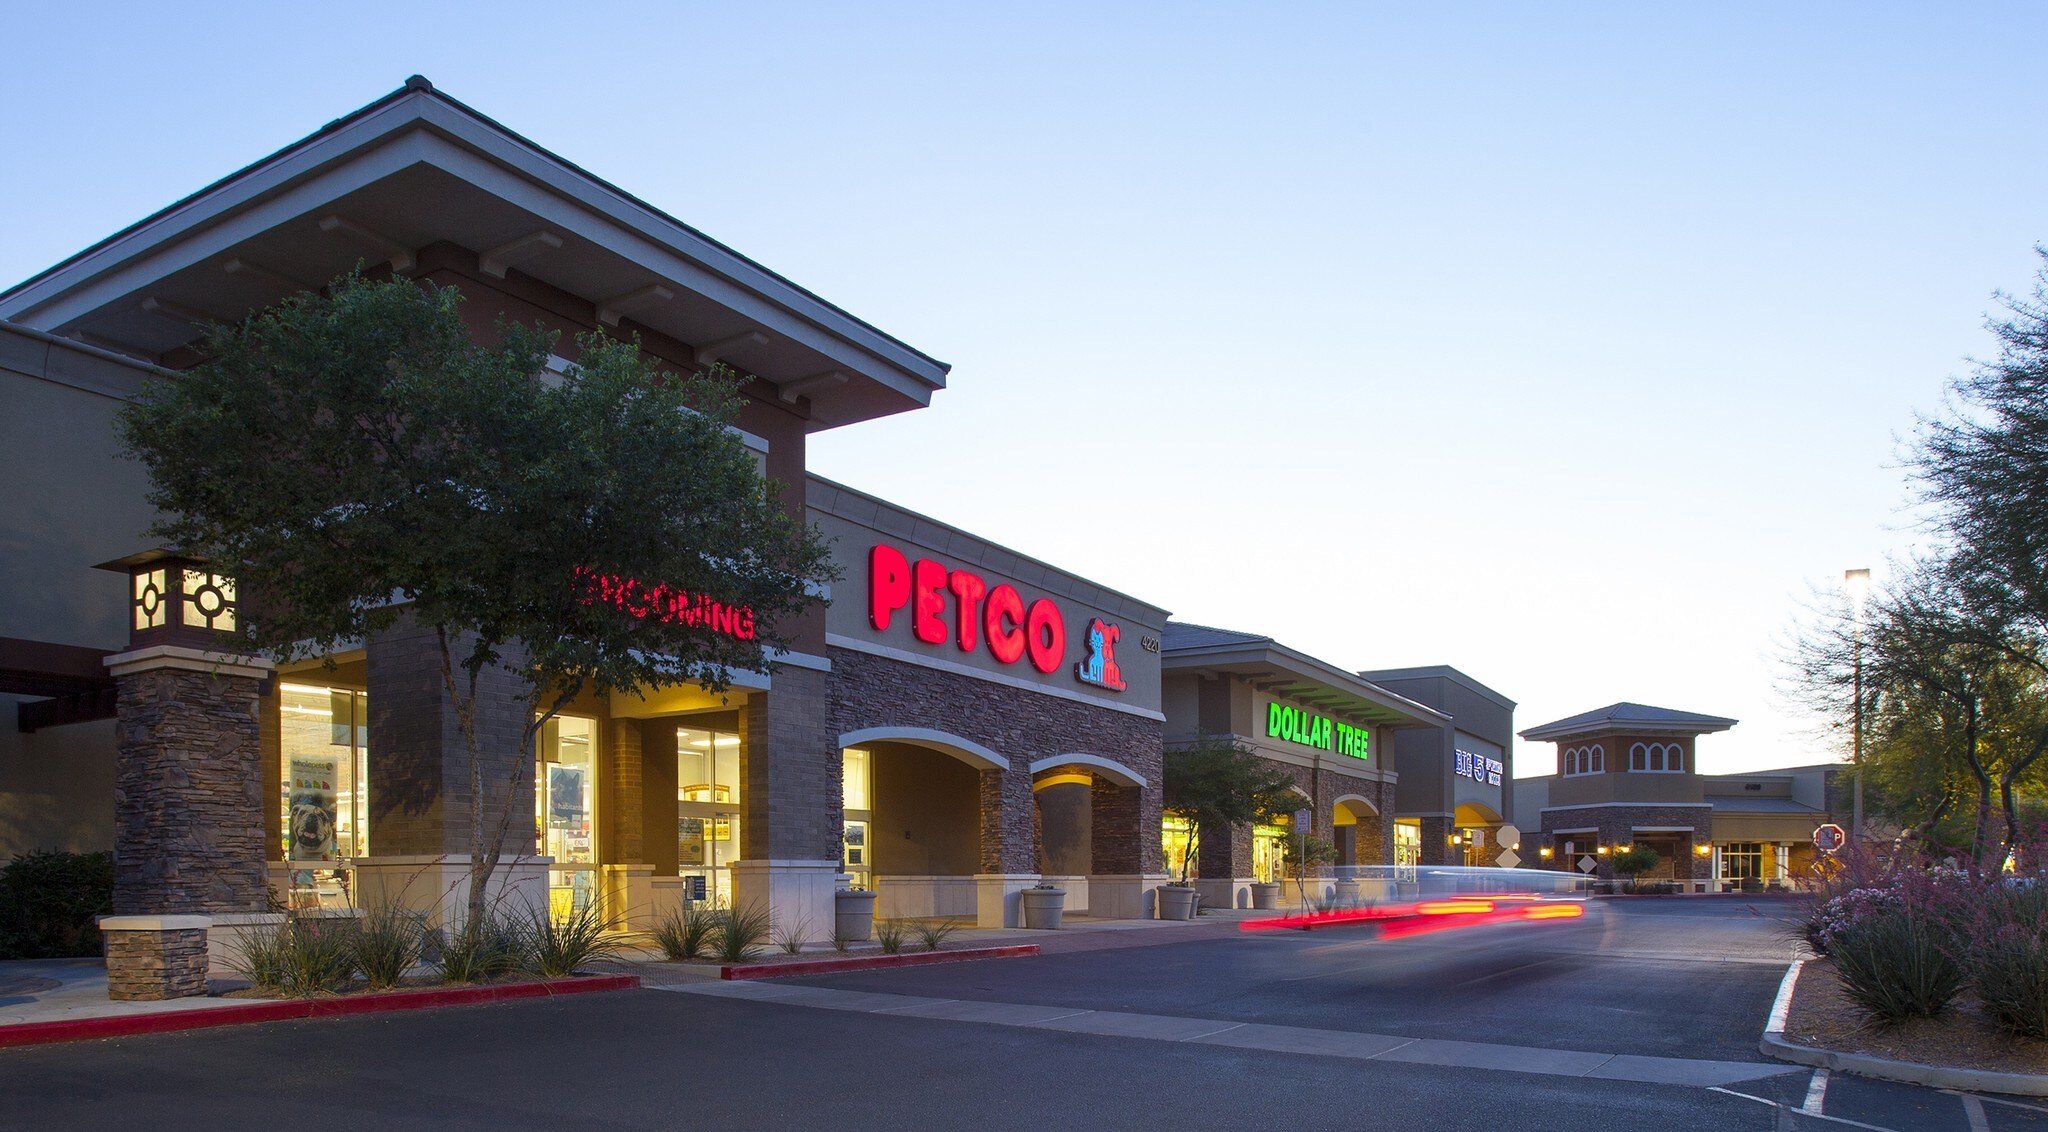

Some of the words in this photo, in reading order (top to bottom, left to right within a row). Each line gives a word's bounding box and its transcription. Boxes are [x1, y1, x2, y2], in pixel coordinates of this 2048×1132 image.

[869, 543, 1066, 674] PETCO
[1141, 635, 1159, 653] 4220
[1268, 702, 1332, 750] DOLLAR
[1336, 722, 1369, 760] TREE
[1455, 749, 1473, 778] BIG
[1473, 753, 1485, 782] 5
